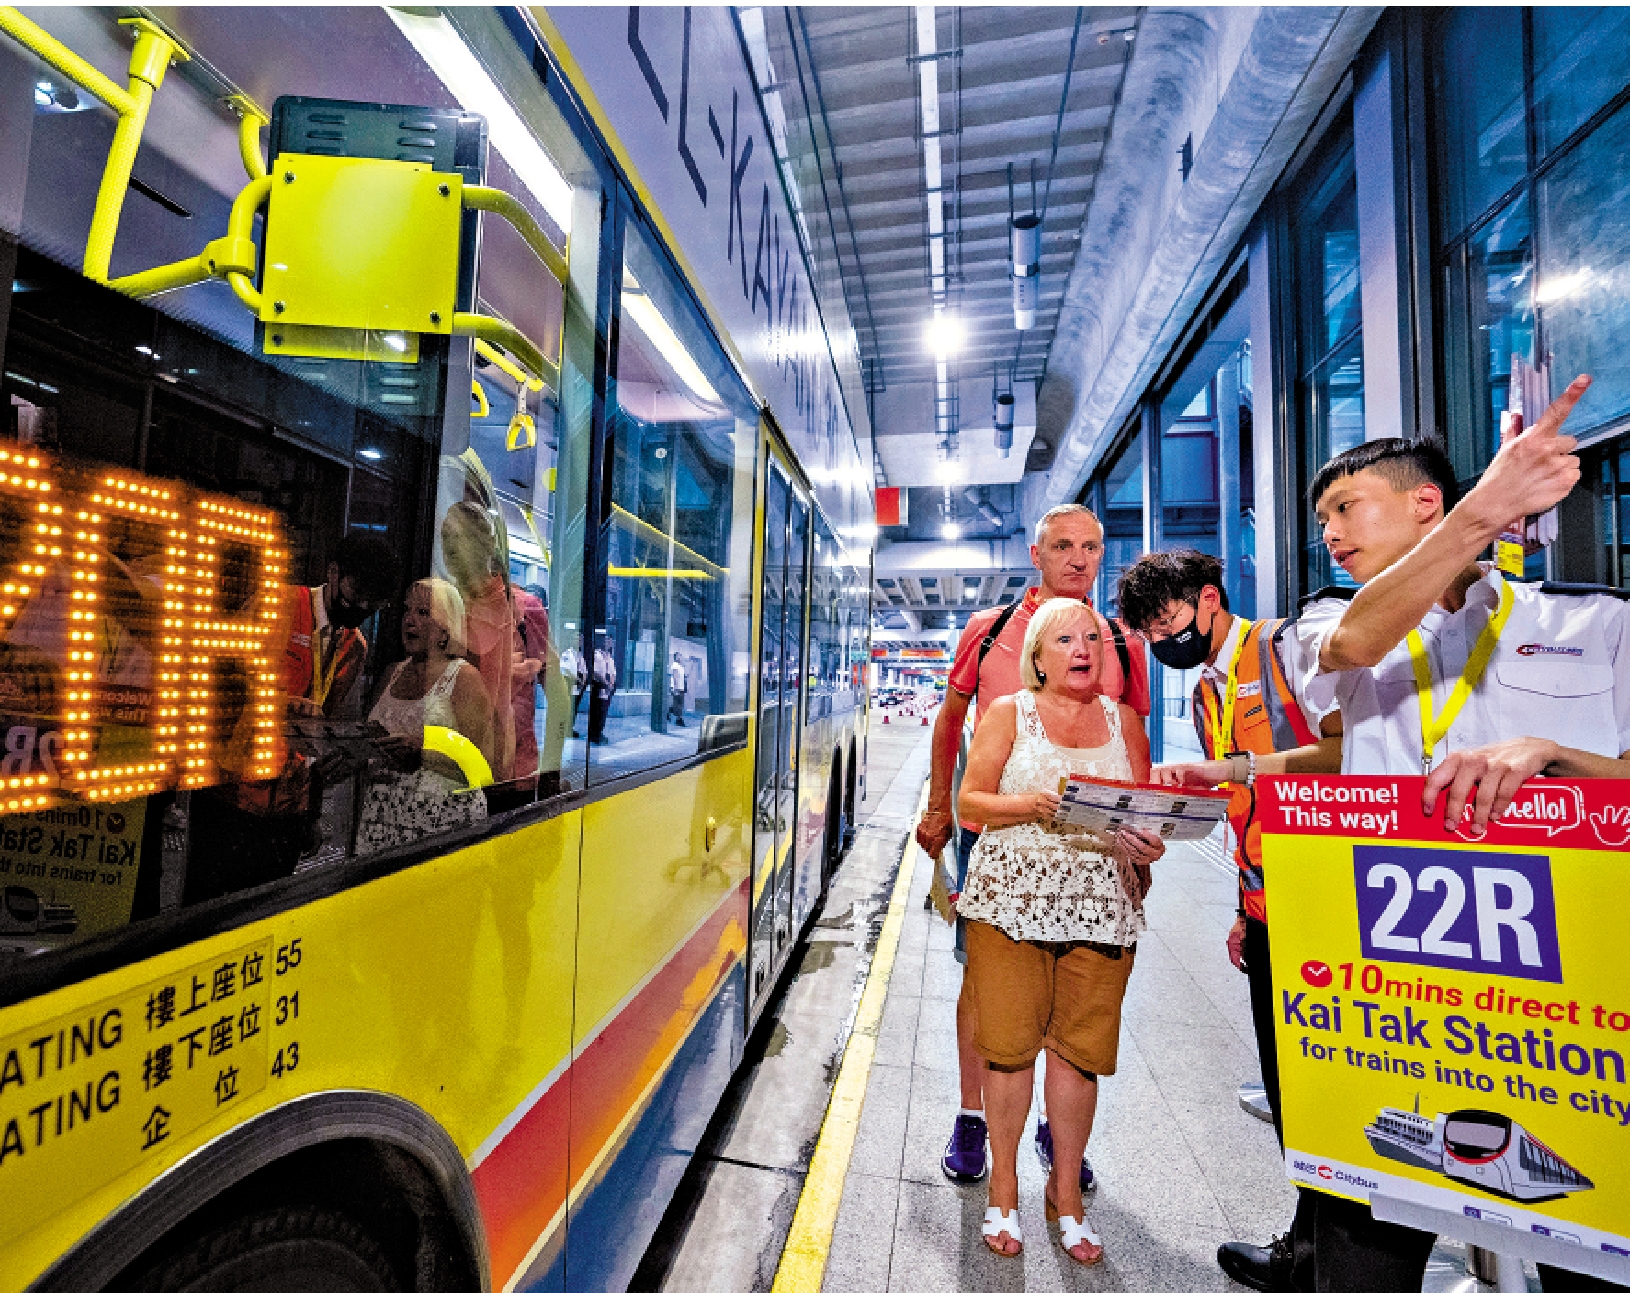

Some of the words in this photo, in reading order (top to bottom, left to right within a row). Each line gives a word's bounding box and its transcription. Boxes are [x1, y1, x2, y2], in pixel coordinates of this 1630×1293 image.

[1274, 780, 1399, 804] Welcome!
[1279, 805, 1332, 828] This
[1339, 810, 1399, 835] way!
[1366, 862, 1543, 968] 22R
[0, 1008, 123, 1094] ATING
[144, 951, 264, 1032] 樓上座位
[275, 937, 302, 977] 55
[1282, 989, 1342, 1034] Kai
[1352, 999, 1432, 1050] Tak
[1443, 1014, 1627, 1084] Station
[1338, 962, 1463, 1008] 10mins
[1474, 985, 1580, 1026] direct
[1591, 1004, 1630, 1032] to
[0, 1070, 120, 1167] ATING
[141, 1003, 261, 1092] 樓下座位
[275, 990, 299, 1026] 31
[270, 1041, 299, 1079] 43
[1299, 1036, 1337, 1062] for
[1344, 1045, 1426, 1081] trains
[1434, 1060, 1495, 1093] into
[1503, 1074, 1558, 1105] the
[1569, 1089, 1630, 1127] city
